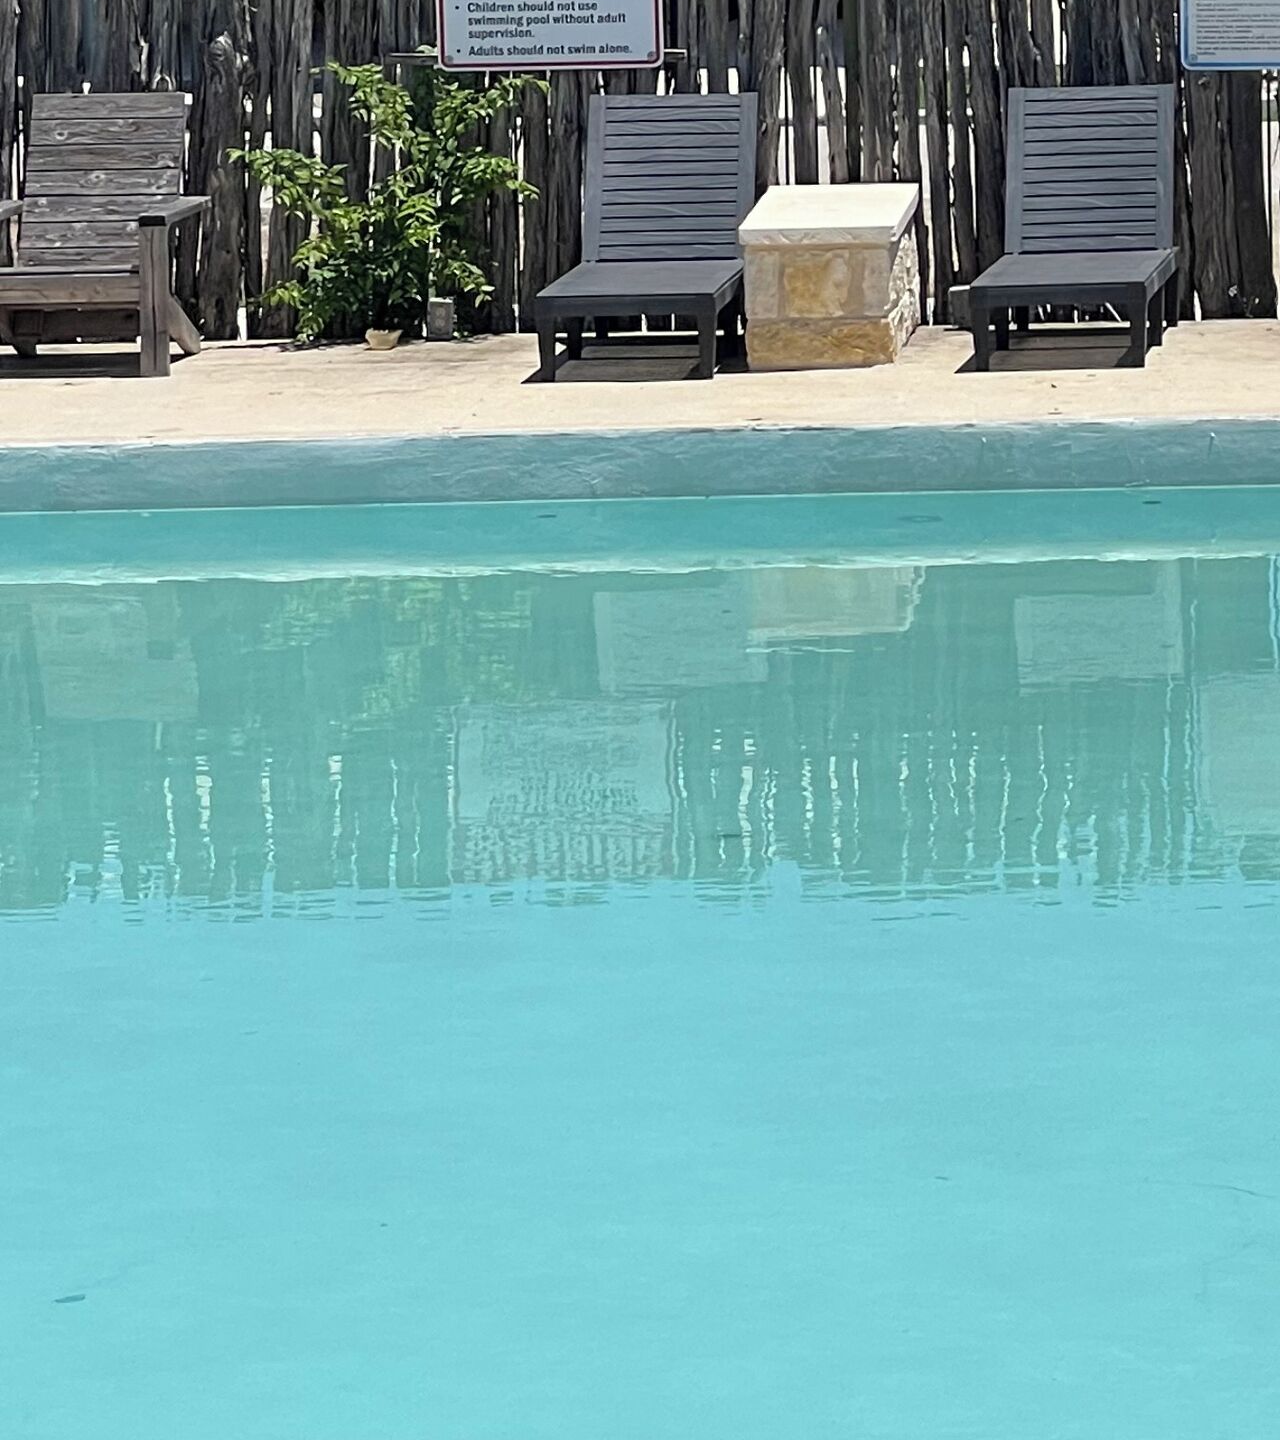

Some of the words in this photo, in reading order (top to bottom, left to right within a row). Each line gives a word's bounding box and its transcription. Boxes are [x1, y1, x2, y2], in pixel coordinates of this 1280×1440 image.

[467, 1, 514, 13] Children
[517, 1, 554, 12] should
[557, 1, 575, 11] not
[578, 2, 598, 11] use
[468, 14, 524, 27] swimming
[526, 14, 550, 27] pool
[552, 13, 595, 24] without
[597, 13, 626, 24] adult
[468, 27, 535, 40] supervision.
[468, 45, 504, 56] Adults
[507, 44, 544, 56] should
[546, 45, 565, 55] not
[568, 44, 596, 54] swim
[598, 43, 633, 54] alone.
